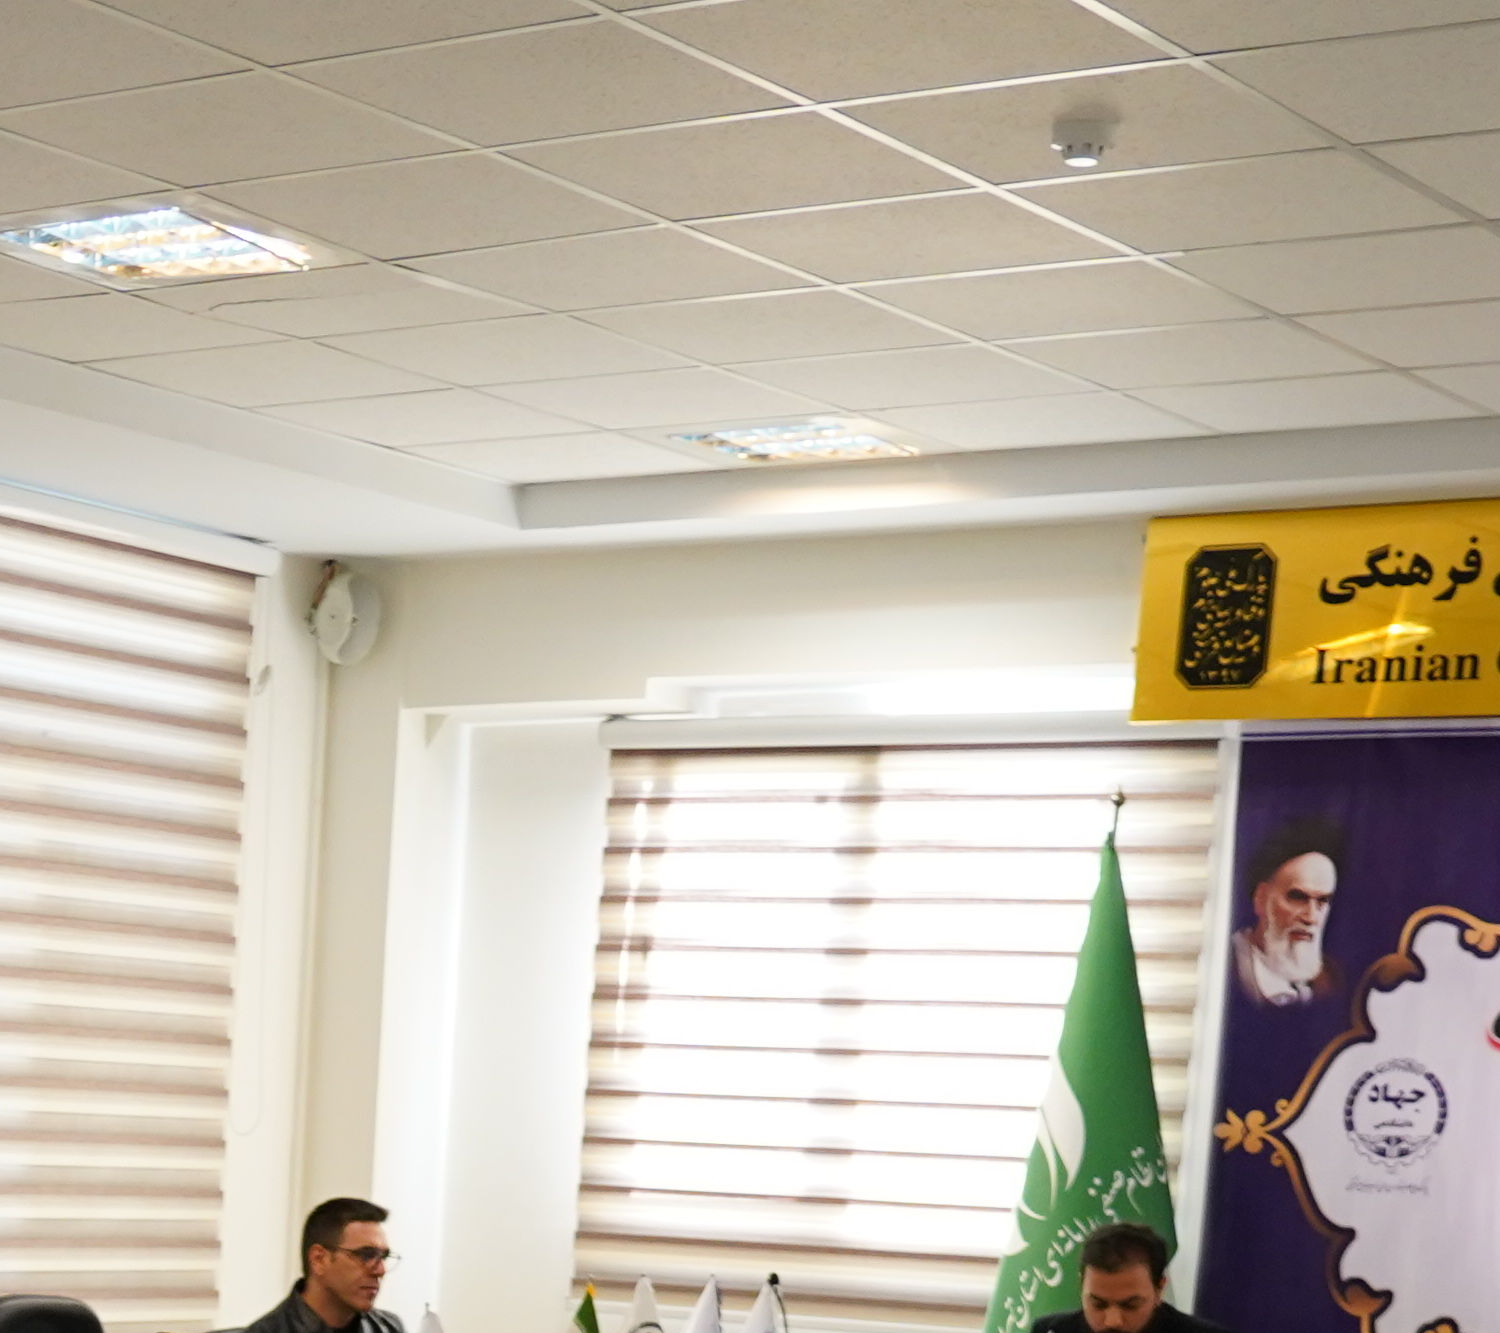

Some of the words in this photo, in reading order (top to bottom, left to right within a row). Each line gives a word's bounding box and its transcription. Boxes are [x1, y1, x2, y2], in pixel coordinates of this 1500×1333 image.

[1319, 535, 1483, 605] فرهنگی
[1310, 643, 1481, 685] Iranian
[1368, 1083, 1426, 1112] جهاد
